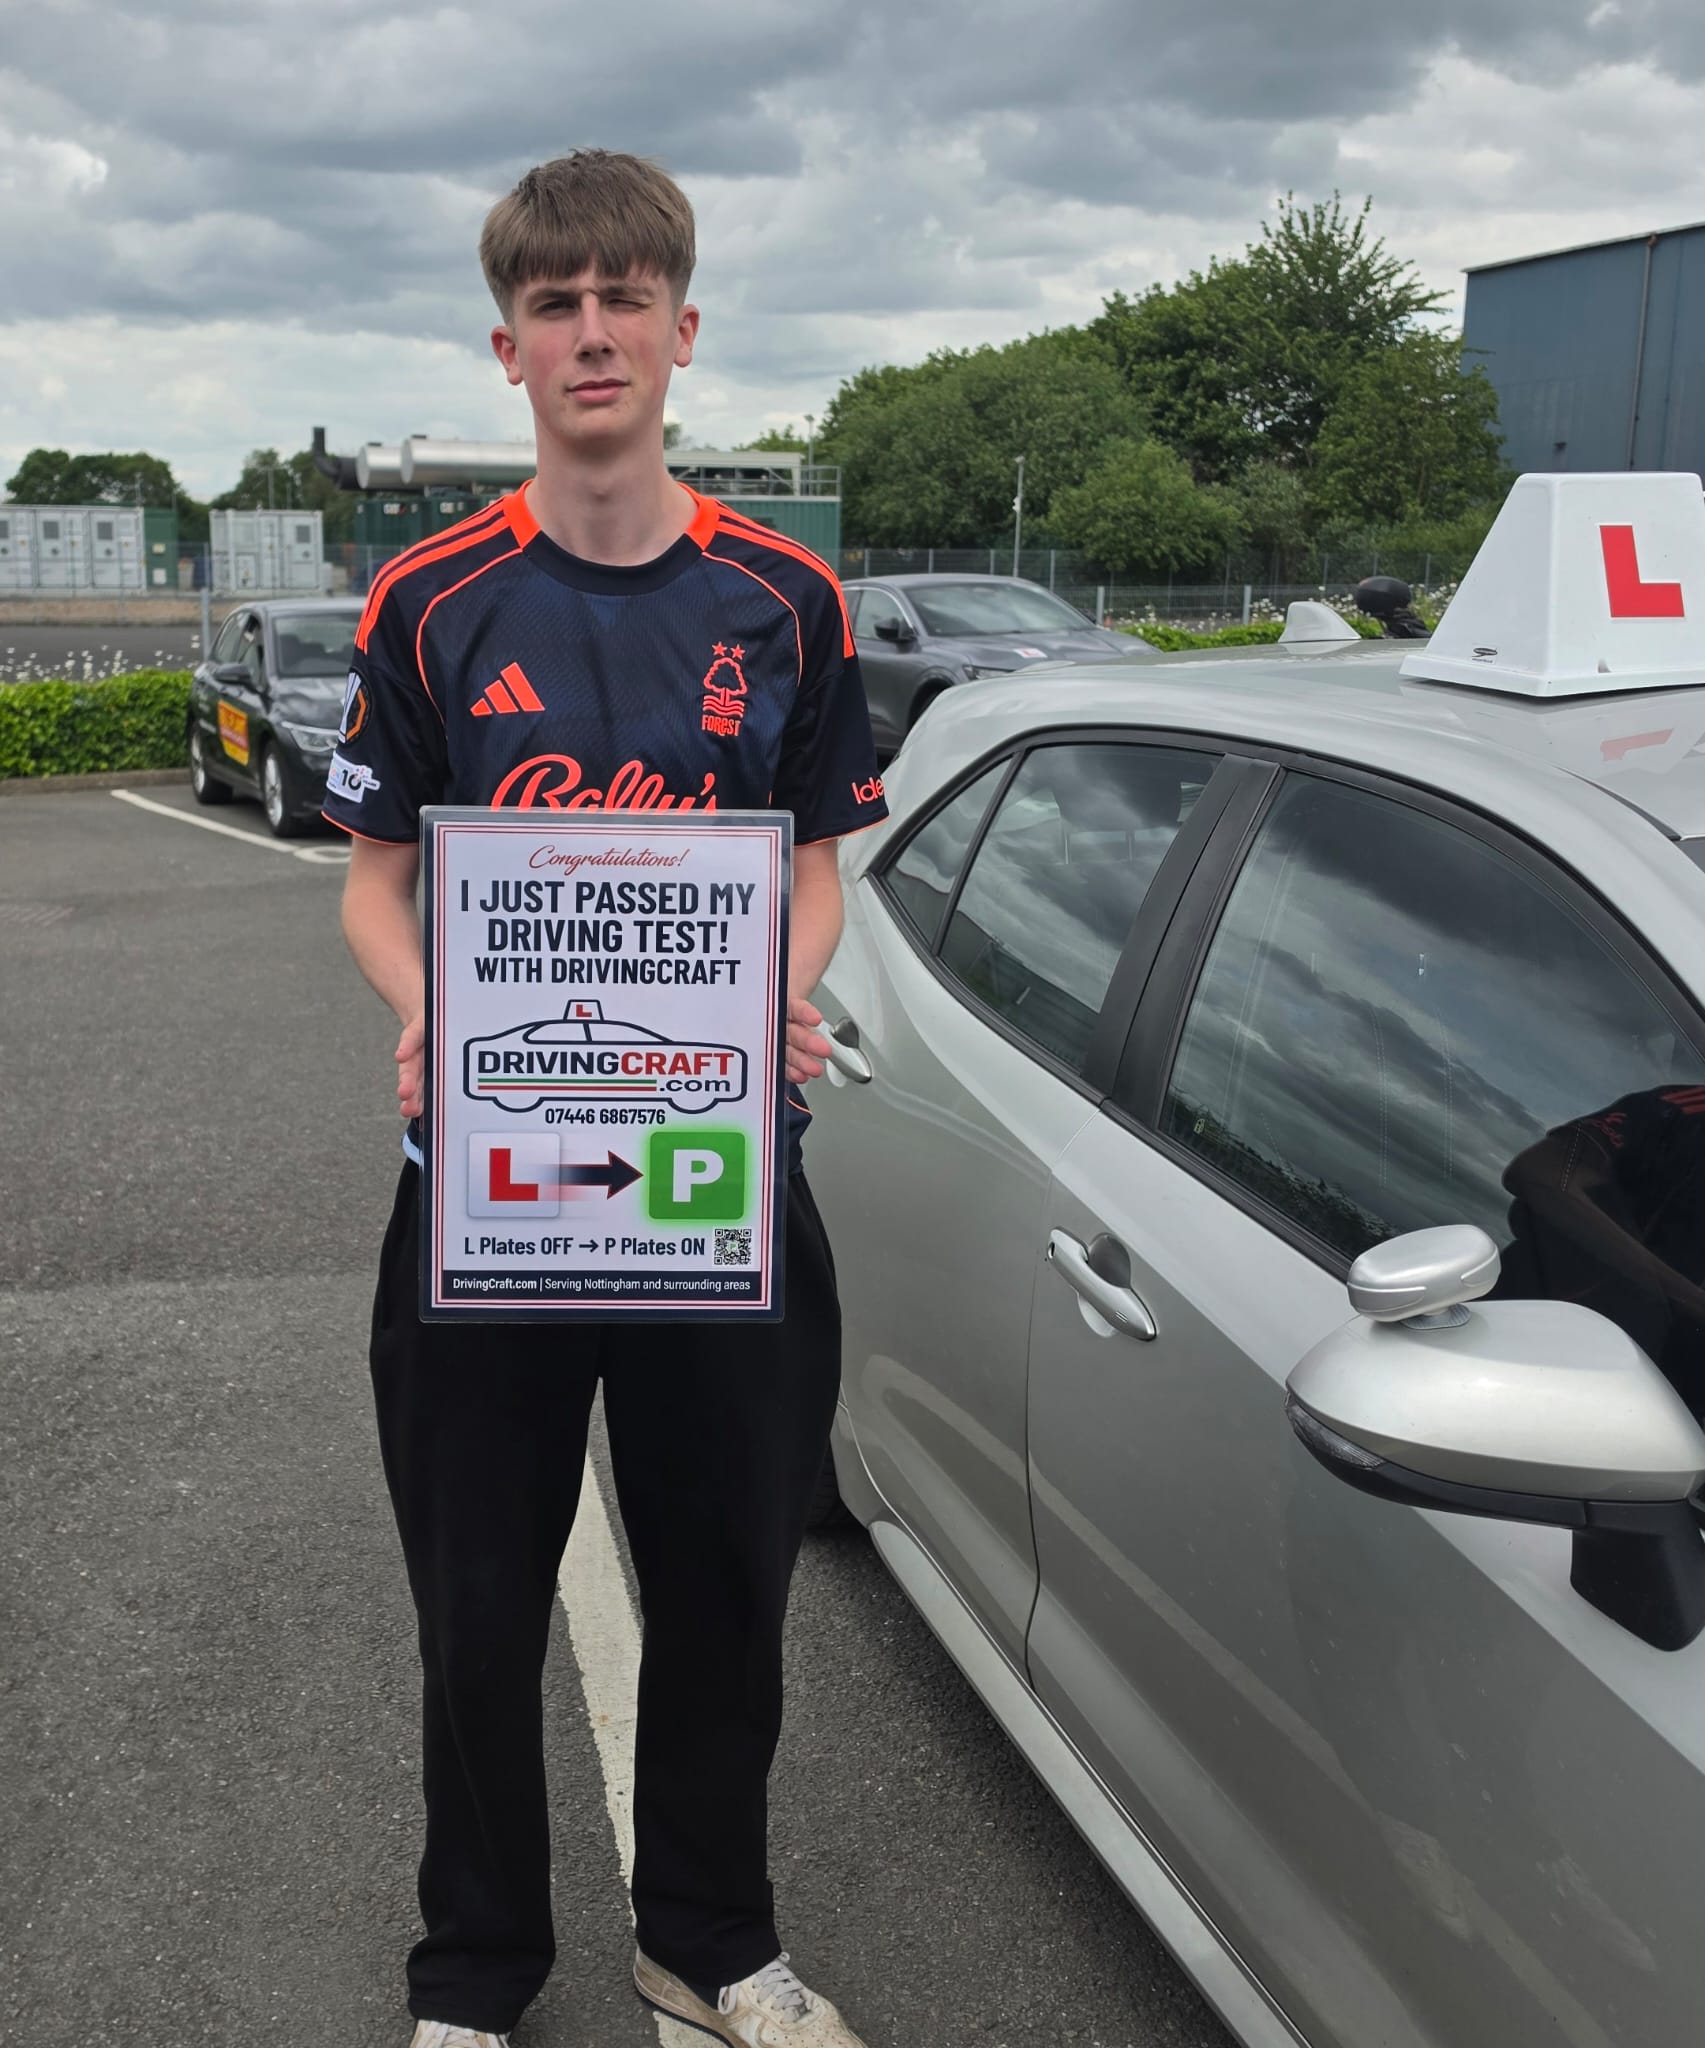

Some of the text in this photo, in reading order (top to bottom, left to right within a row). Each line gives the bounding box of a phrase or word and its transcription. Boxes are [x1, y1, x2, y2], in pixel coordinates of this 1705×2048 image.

[1600, 525, 1685, 618] L
[528, 844, 690, 875] Congratulations!
[461, 879, 756, 915] I JUST PASSED MY
[487, 919, 729, 954] DRIVING TEST!
[474, 957, 741, 985] WITH DRIVINGCRAFT
[576, 1004, 592, 1018] L
[478, 1050, 735, 1076] DRIVINGCRAFT
[659, 1079, 731, 1093] .com
[545, 1108, 666, 1125] 07446 6867576
[489, 1148, 539, 1201] L
[672, 1149, 725, 1203] P
[464, 1237, 706, 1255] L Plates OFF P Plates ON
[453, 1278, 537, 1292] DrivingCraft.com
[544, 1278, 582, 1292] Serving
[584, 1279, 640, 1292] Nottingham
[642, 1279, 662, 1290] and
[663, 1279, 722, 1292] surrounding
[723, 1281, 751, 1290] areas
